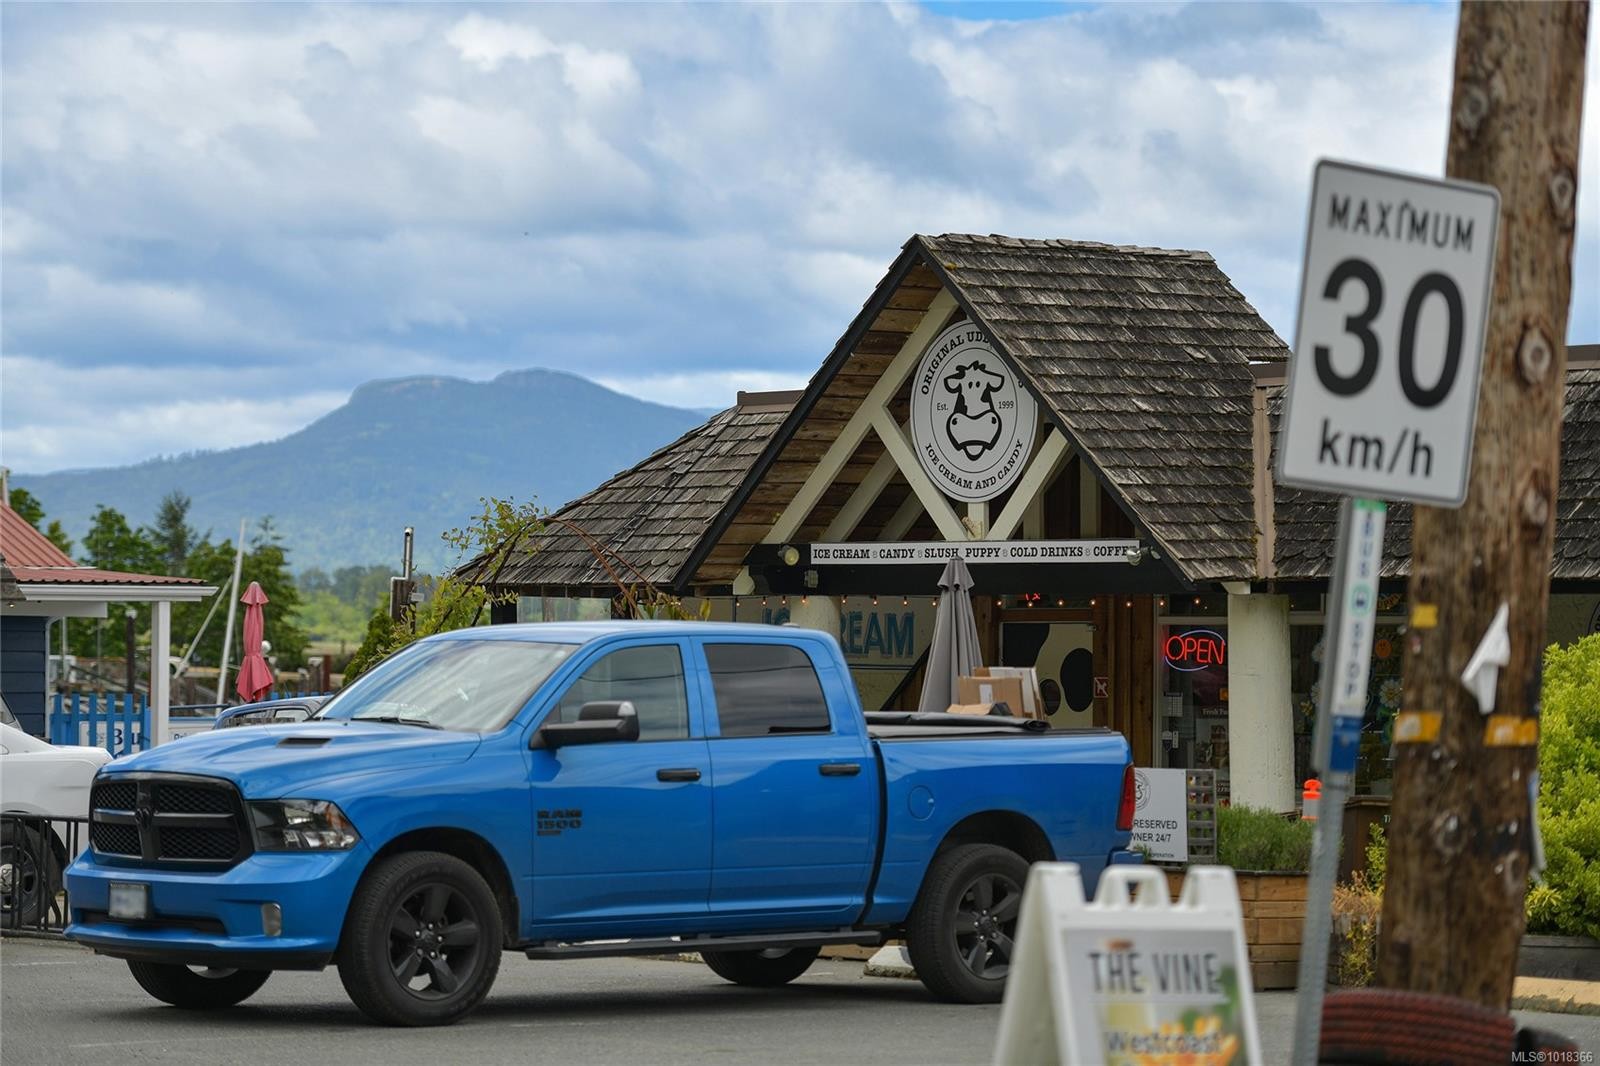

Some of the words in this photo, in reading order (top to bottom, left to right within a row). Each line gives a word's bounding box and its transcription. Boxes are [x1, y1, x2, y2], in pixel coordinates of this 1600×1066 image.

[1327, 192, 1475, 253] MAXIMUM
[1313, 257, 1465, 411] 30
[921, 334, 965, 395] ORIGINAL
[936, 402, 949, 411] Est.
[998, 401, 1015, 410] 1999
[925, 443, 940, 465] ICE
[938, 463, 973, 490] CREAM
[974, 475, 997, 490] AND
[997, 438, 1023, 480] CANDY
[1317, 417, 1434, 478] km/h
[813, 548, 831, 559] ICE
[832, 548, 871, 559] CREAM
[879, 548, 916, 559] CANDY
[924, 547, 959, 559] SLUSH
[965, 546, 1001, 558] PUPPY
[1010, 546, 1038, 558] COLD
[1040, 546, 1084, 557] DRINKS
[1093, 545, 1137, 557] COFFE
[1165, 635, 1226, 665] OPEN
[1134, 819, 1178, 830] RESERVED
[1155, 833, 1171, 843] 24/7
[1087, 951, 1145, 994] THE
[1151, 952, 1222, 995] VINE
